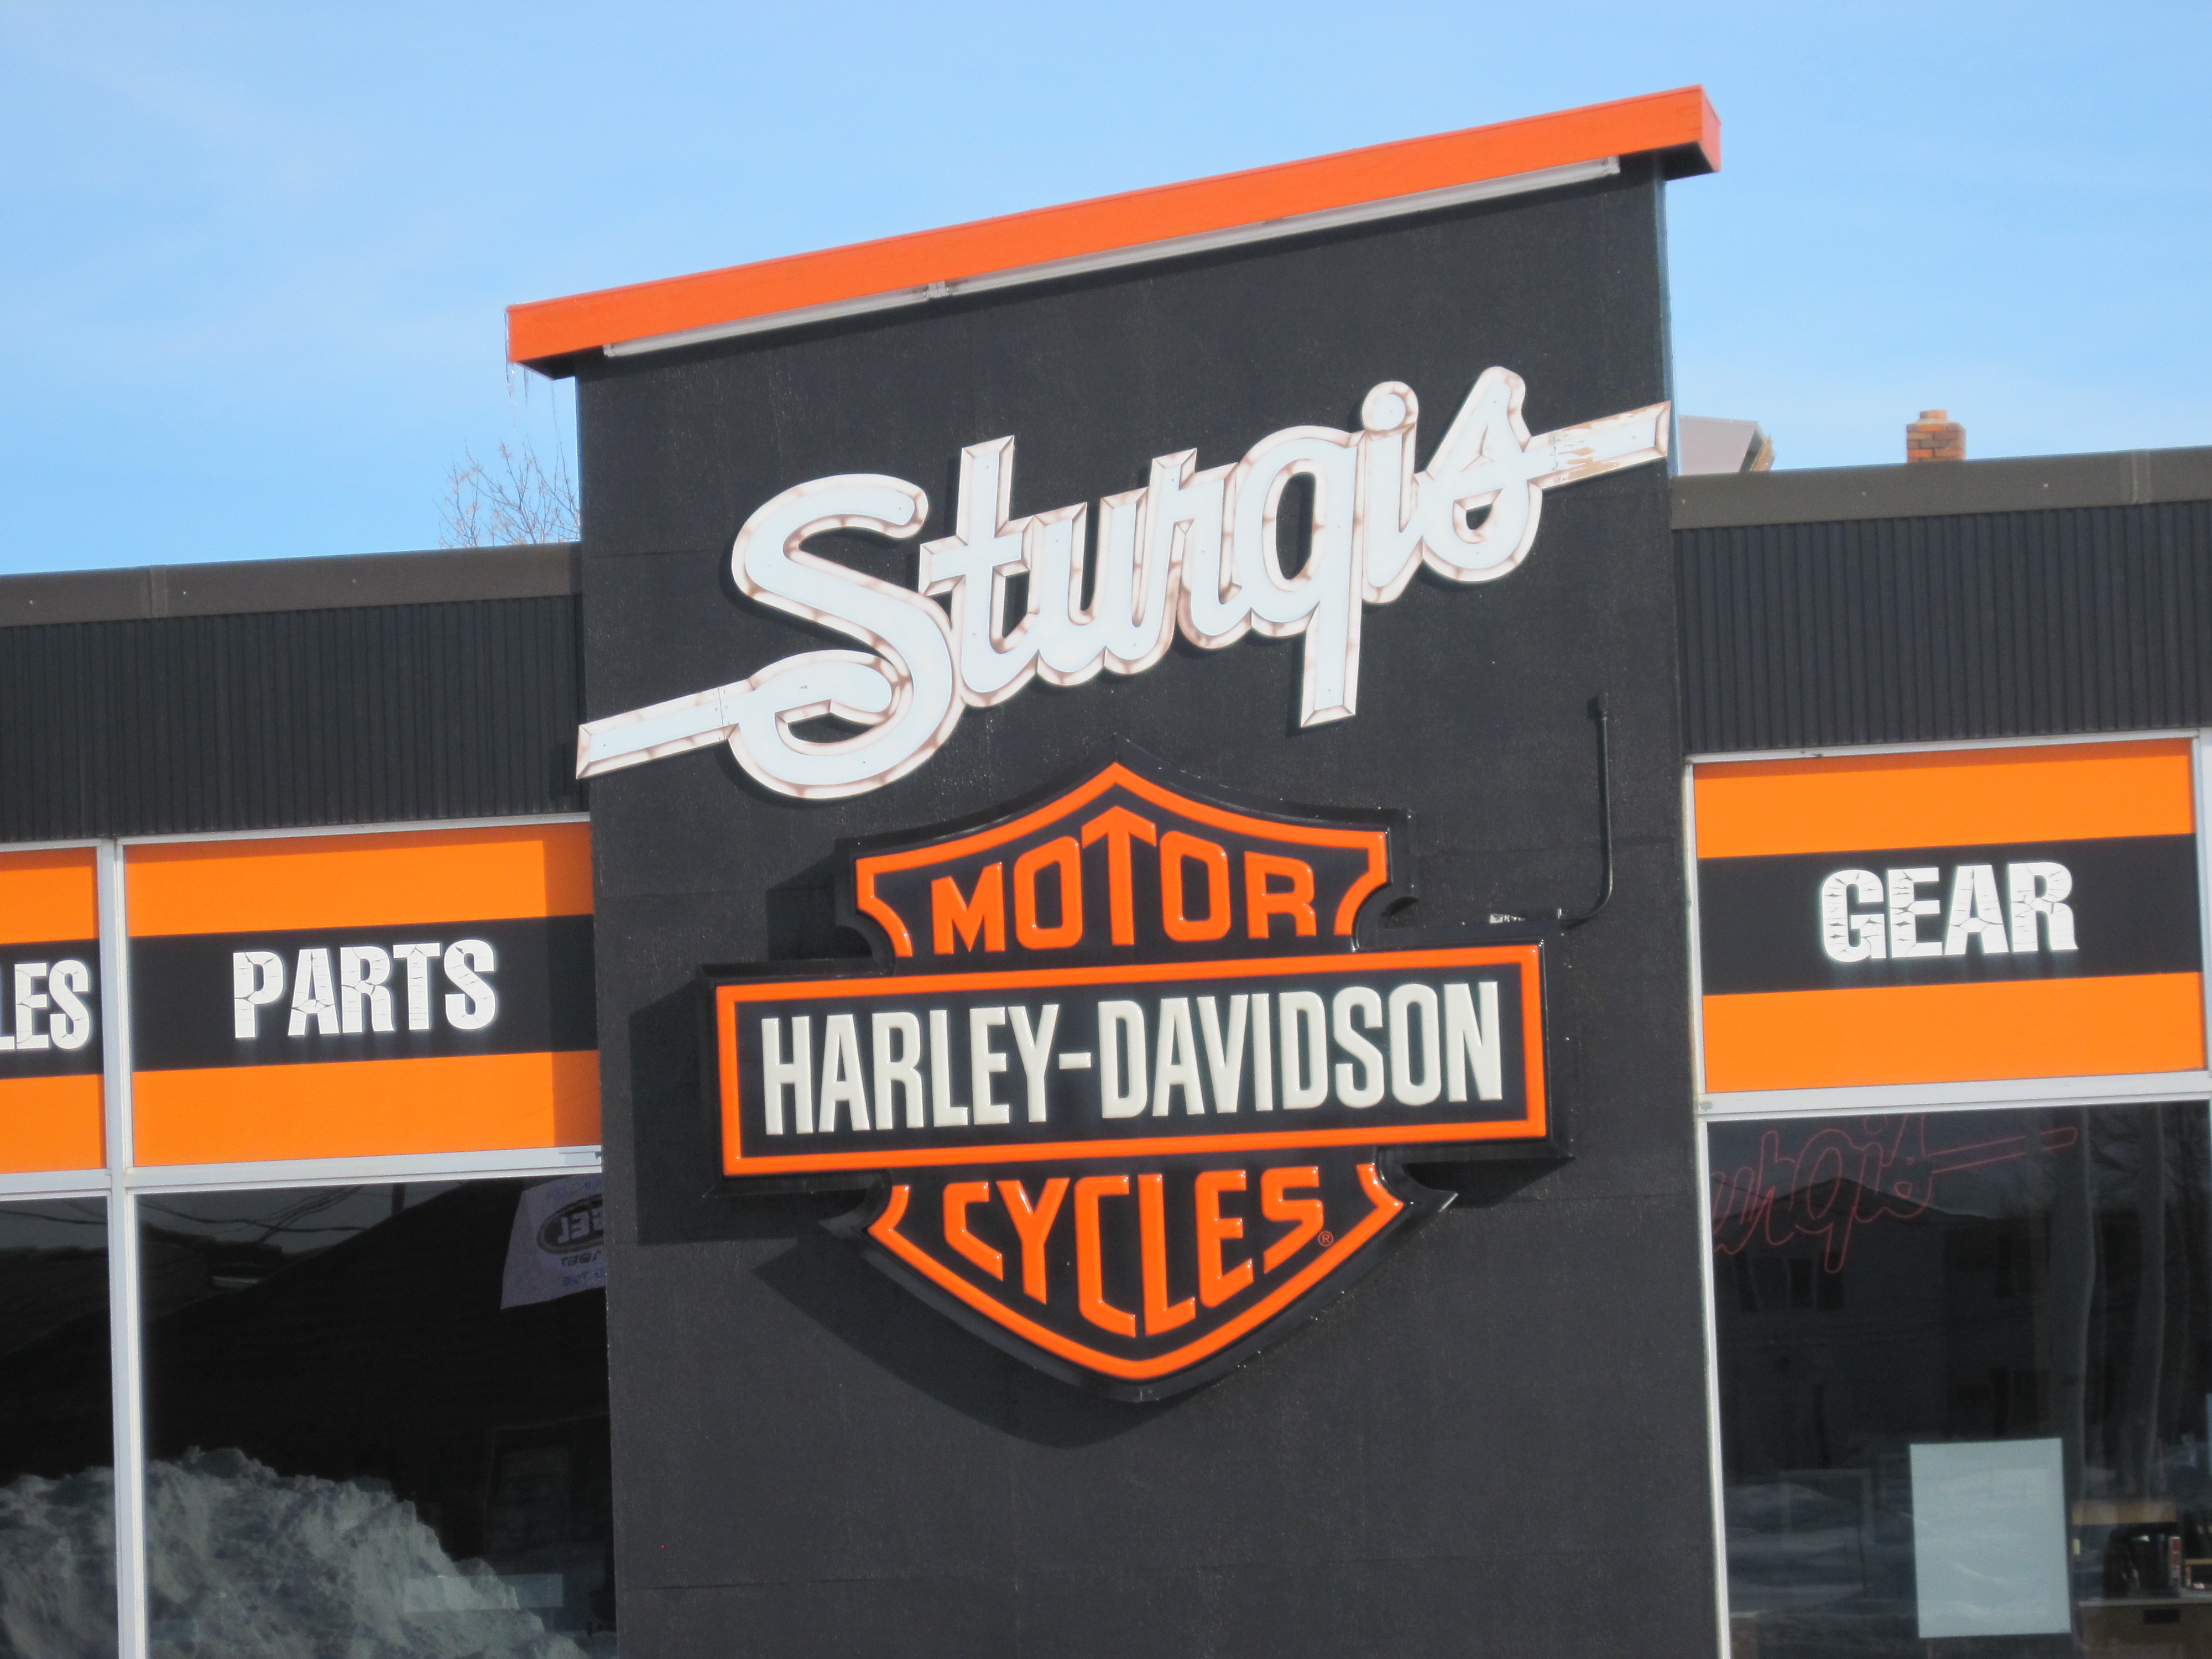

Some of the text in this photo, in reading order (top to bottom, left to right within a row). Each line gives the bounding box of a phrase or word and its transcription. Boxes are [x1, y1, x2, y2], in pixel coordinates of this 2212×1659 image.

[575, 366, 1671, 801] Sturgis
[930, 805, 1318, 954] MOTOR
[1822, 861, 2079, 963] GEAR
[232, 938, 496, 1039] PARTS
[761, 981, 1503, 1136] HARLEY-DAVIDSON
[943, 1166, 1324, 1338] CYCLES
